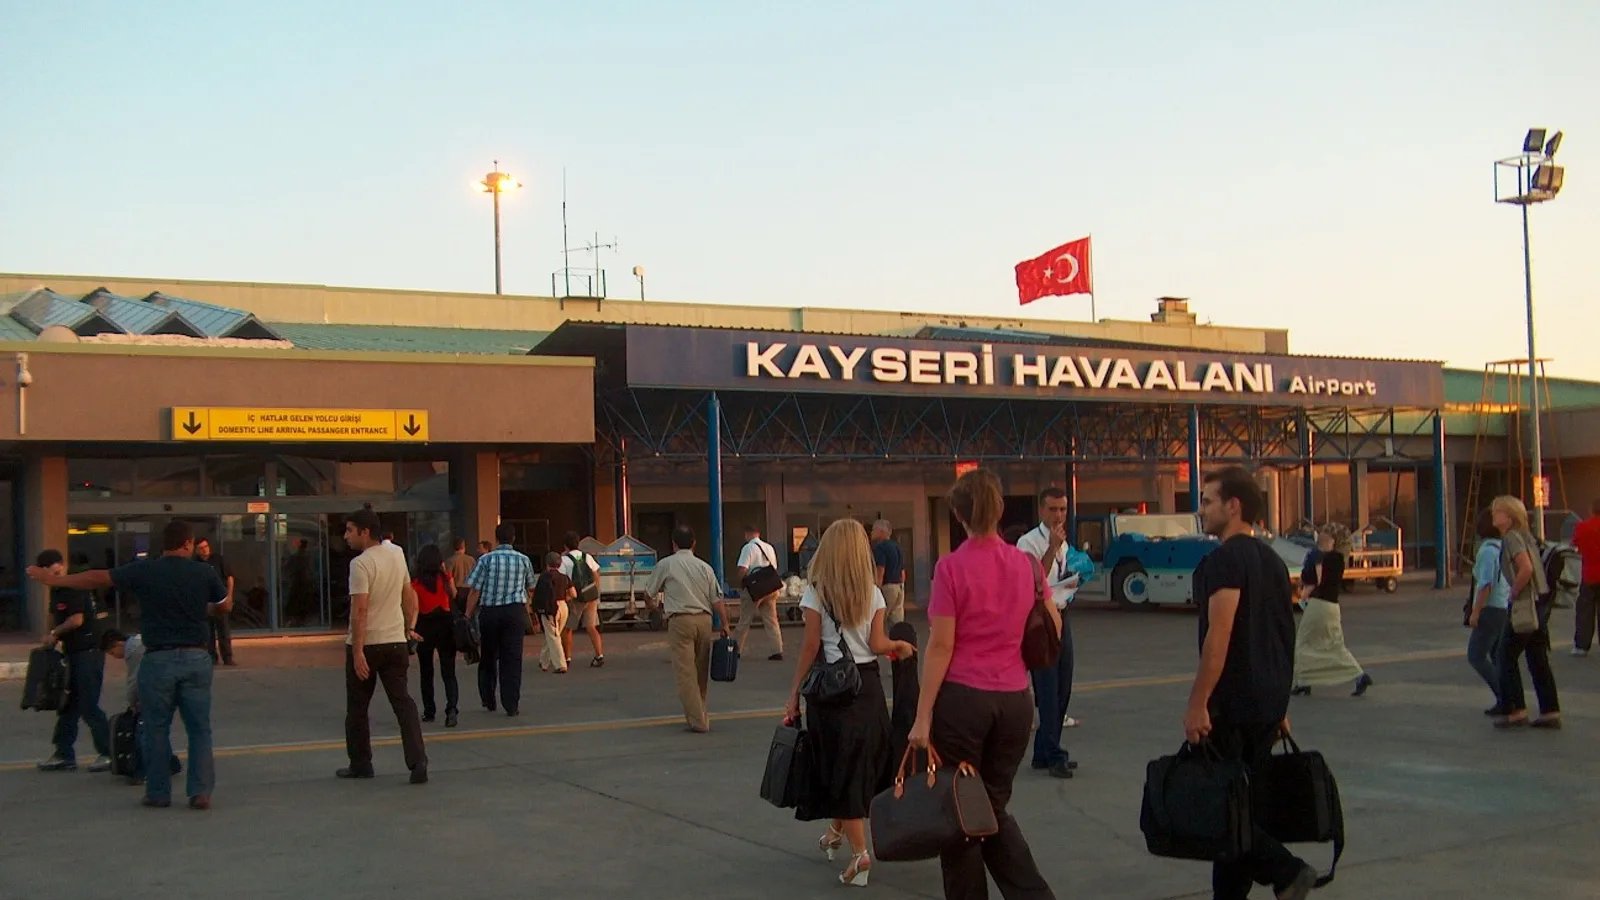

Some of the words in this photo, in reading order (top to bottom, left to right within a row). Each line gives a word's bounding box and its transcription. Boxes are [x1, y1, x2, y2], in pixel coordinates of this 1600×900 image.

[747, 341, 995, 386] KAYSERİ
[1013, 353, 1275, 394] HAVAALANI
[260, 414, 288, 422] HATLAR
[218, 426, 255, 434] DOMESTIC
[307, 427, 349, 435] PASSANGER
[351, 427, 388, 435] ENTRANCE
